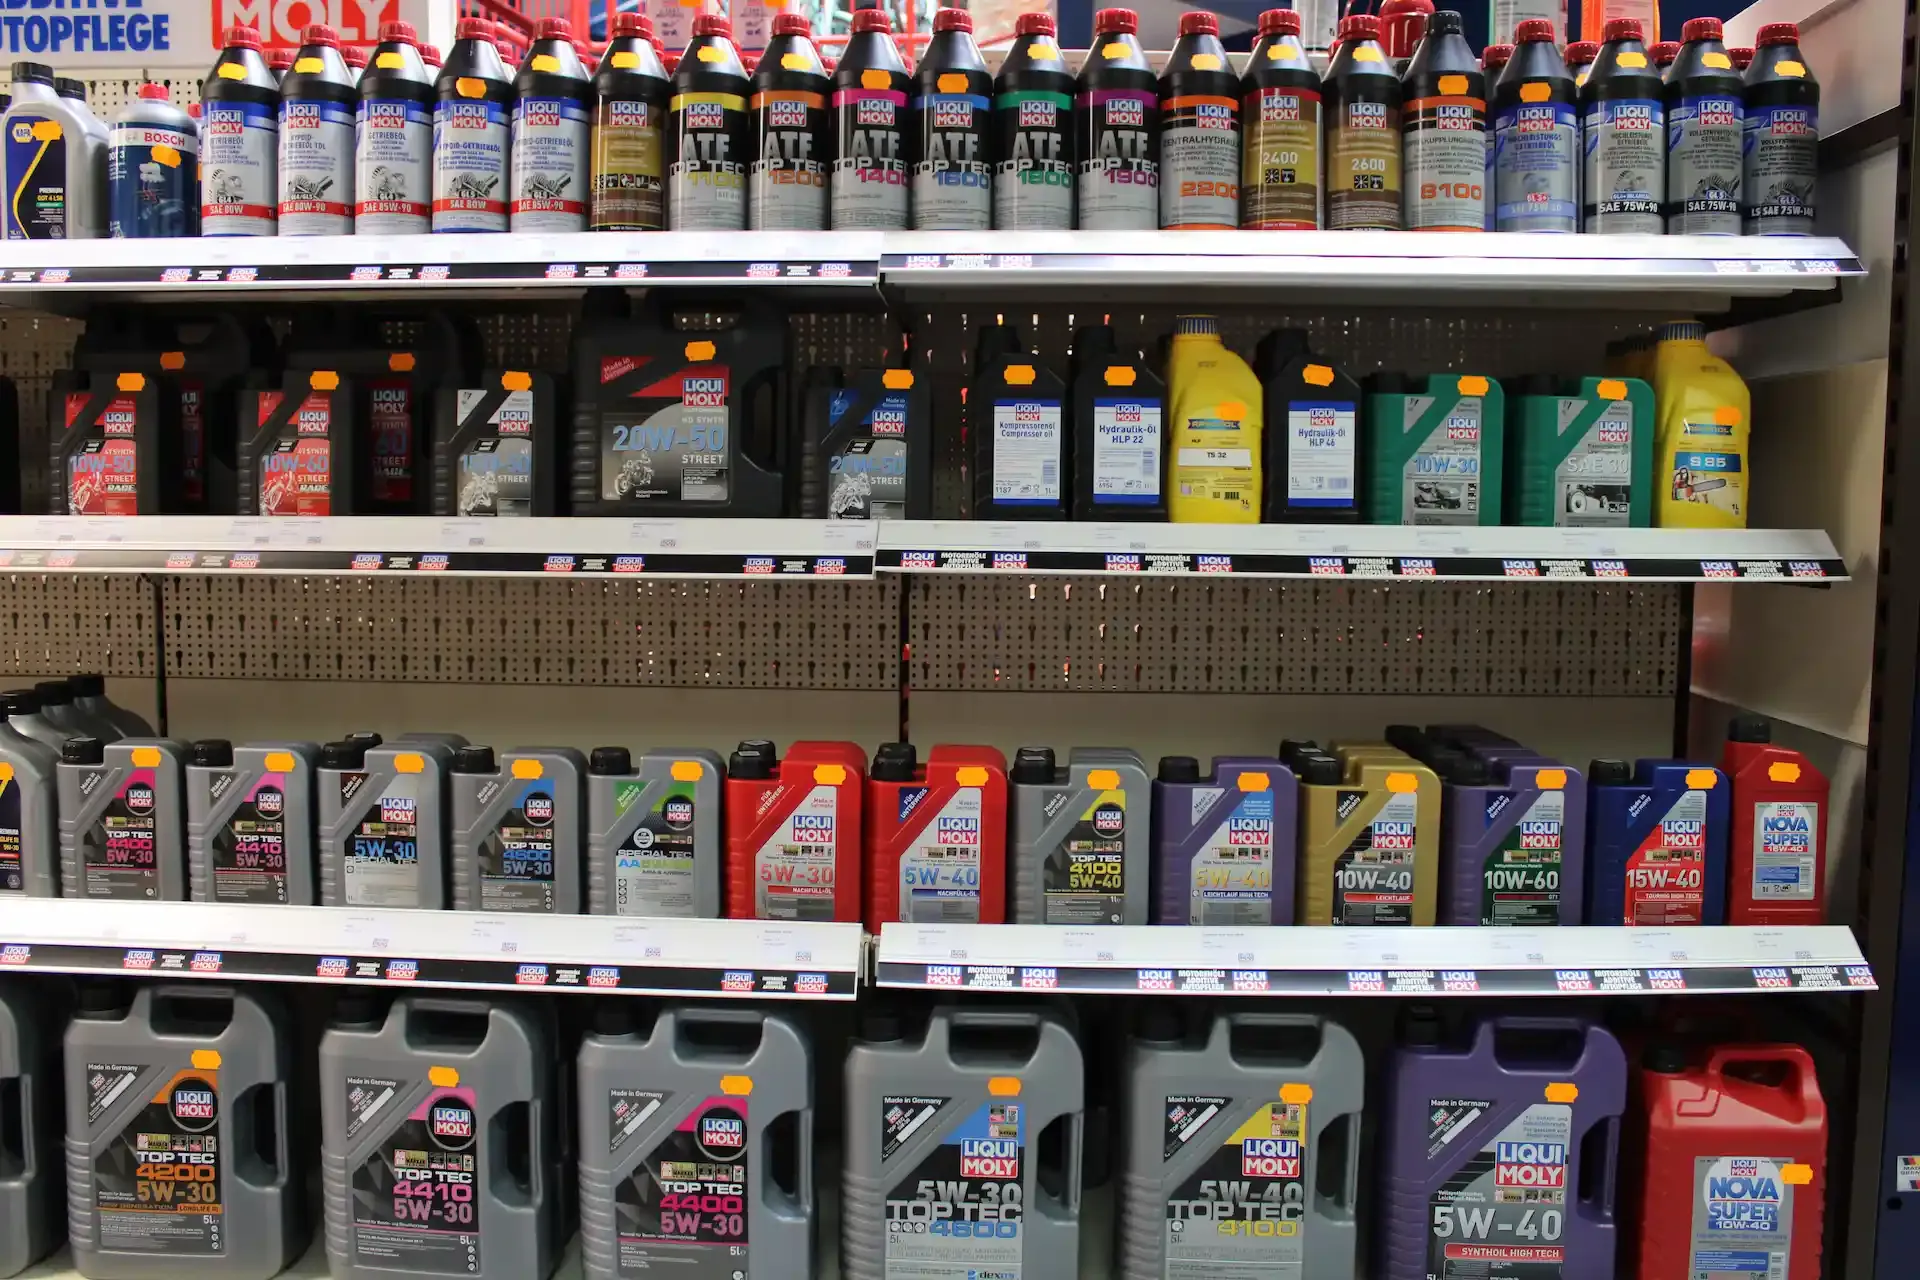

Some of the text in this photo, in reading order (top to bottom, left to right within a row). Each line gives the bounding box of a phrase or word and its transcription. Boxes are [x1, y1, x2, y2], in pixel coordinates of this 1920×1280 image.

[0, 15, 169, 52] TOPFLEGE
[454, 106, 486, 116] LIQUI
[860, 100, 892, 112] LIQUI
[1200, 106, 1229, 117] LIQUI
[860, 113, 893, 124] MOLY
[1616, 107, 1650, 118] LIQUI
[454, 118, 486, 128] MOLY
[1199, 118, 1230, 129] MOLY
[1616, 120, 1650, 130] MOLY
[144, 132, 184, 145] BOSCH
[851, 130, 900, 158] ATF
[682, 134, 730, 160] ATF
[929, 132, 978, 160] ATF
[1263, 152, 1297, 164] 2400
[707, 160, 744, 175] TEC
[913, 160, 990, 176] TOP TEC
[1352, 159, 1386, 170] 2600
[1421, 184, 1482, 200] 8100
[1600, 202, 1658, 212] SAE 75W-90
[1688, 202, 1736, 211] SAE 75W-90
[685, 380, 722, 392] LIQUI
[685, 394, 723, 406] MOLY
[106, 413, 132, 422] LIQUI
[300, 412, 326, 422] LIQUI
[696, 416, 724, 424] SYNTH
[106, 424, 133, 433] MOLY
[300, 422, 327, 432] MOLY
[1100, 424, 1156, 434] Hydraulik-Öl
[1298, 428, 1346, 438] Hydraulik-Öl
[613, 426, 724, 451] 20W-50
[1112, 435, 1144, 444] HLP 22
[1310, 438, 1336, 446] HLP 46
[70, 456, 134, 472] 10W-50
[262, 455, 328, 472] 10W-60
[682, 455, 724, 464] STREET
[1414, 455, 1478, 473] 10W-30
[1566, 457, 1628, 473] SAE 30
[1107, 555, 1139, 563] LIQUI
[1107, 564, 1140, 572] MOLY
[900, 788, 928, 818] UNTERWEGS
[904, 794, 915, 806] FÜR
[795, 816, 832, 828] LIQUI
[940, 819, 977, 830] LIQUI
[1231, 820, 1268, 830] LIQUI
[1764, 818, 1808, 832] NOVA
[1374, 823, 1411, 834] LIQUI
[1522, 823, 1558, 834] LIQUI
[794, 830, 832, 842] MOLY
[939, 832, 977, 843] MOLY
[1230, 832, 1269, 844] MOLY
[1374, 836, 1412, 848] MOLY
[1522, 836, 1559, 847] MOLY
[1764, 834, 1808, 846] SUPER
[106, 840, 152, 850] 4400
[236, 842, 282, 854] 4410
[355, 840, 416, 858] 5W-30
[107, 851, 152, 862] 5W-30
[236, 855, 282, 867] 5W-30
[504, 861, 551, 874] 5W-30
[1070, 864, 1121, 874] 4100
[760, 864, 834, 884] 5W-30
[905, 866, 978, 886] 5W-40
[1196, 869, 1270, 888] 5W-40
[1335, 870, 1412, 890] 10W-40
[1484, 870, 1559, 890] 10W-60
[1626, 870, 1700, 888] 15W-40
[1070, 875, 1121, 888] 5W-40
[178, 1092, 211, 1104] LIQUI
[1458, 1100, 1490, 1108] Germany
[178, 1105, 212, 1116] MOLY
[436, 1110, 469, 1122] LIQUI
[436, 1123, 470, 1135] MOLY
[965, 1141, 1016, 1157] LIQUI
[1246, 1141, 1298, 1157] LIQUI
[1500, 1144, 1562, 1163] LIQUI
[137, 1152, 214, 1164] TOP TEC
[136, 1164, 215, 1182] 4200
[964, 1160, 1016, 1176] MOLY
[1246, 1160, 1298, 1175] MOLY
[394, 1170, 472, 1183] TOP TEC
[1500, 1166, 1562, 1184] MOLY
[137, 1182, 216, 1202] 5W-30
[394, 1183, 472, 1202] 4410
[661, 1182, 742, 1194] TOP TEC
[917, 1181, 1022, 1203] 5W-30
[1200, 1181, 1304, 1201] 5W-40
[1710, 1178, 1779, 1200] NOVA
[660, 1195, 742, 1212] 4400
[394, 1199, 472, 1222] 5W-30
[886, 1201, 1022, 1223] TOP TEC
[1168, 1202, 1304, 1221] TOP TEC
[1709, 1202, 1778, 1220] SUPER
[660, 1212, 743, 1236] 5W-30
[930, 1220, 1016, 1238] 4600
[1218, 1220, 1298, 1236] 4100
[1433, 1206, 1562, 1240] 5W-40
[1716, 1221, 1770, 1230] 10W-40
[1462, 1248, 1560, 1258] SYNTHOIL HIGH TECH
